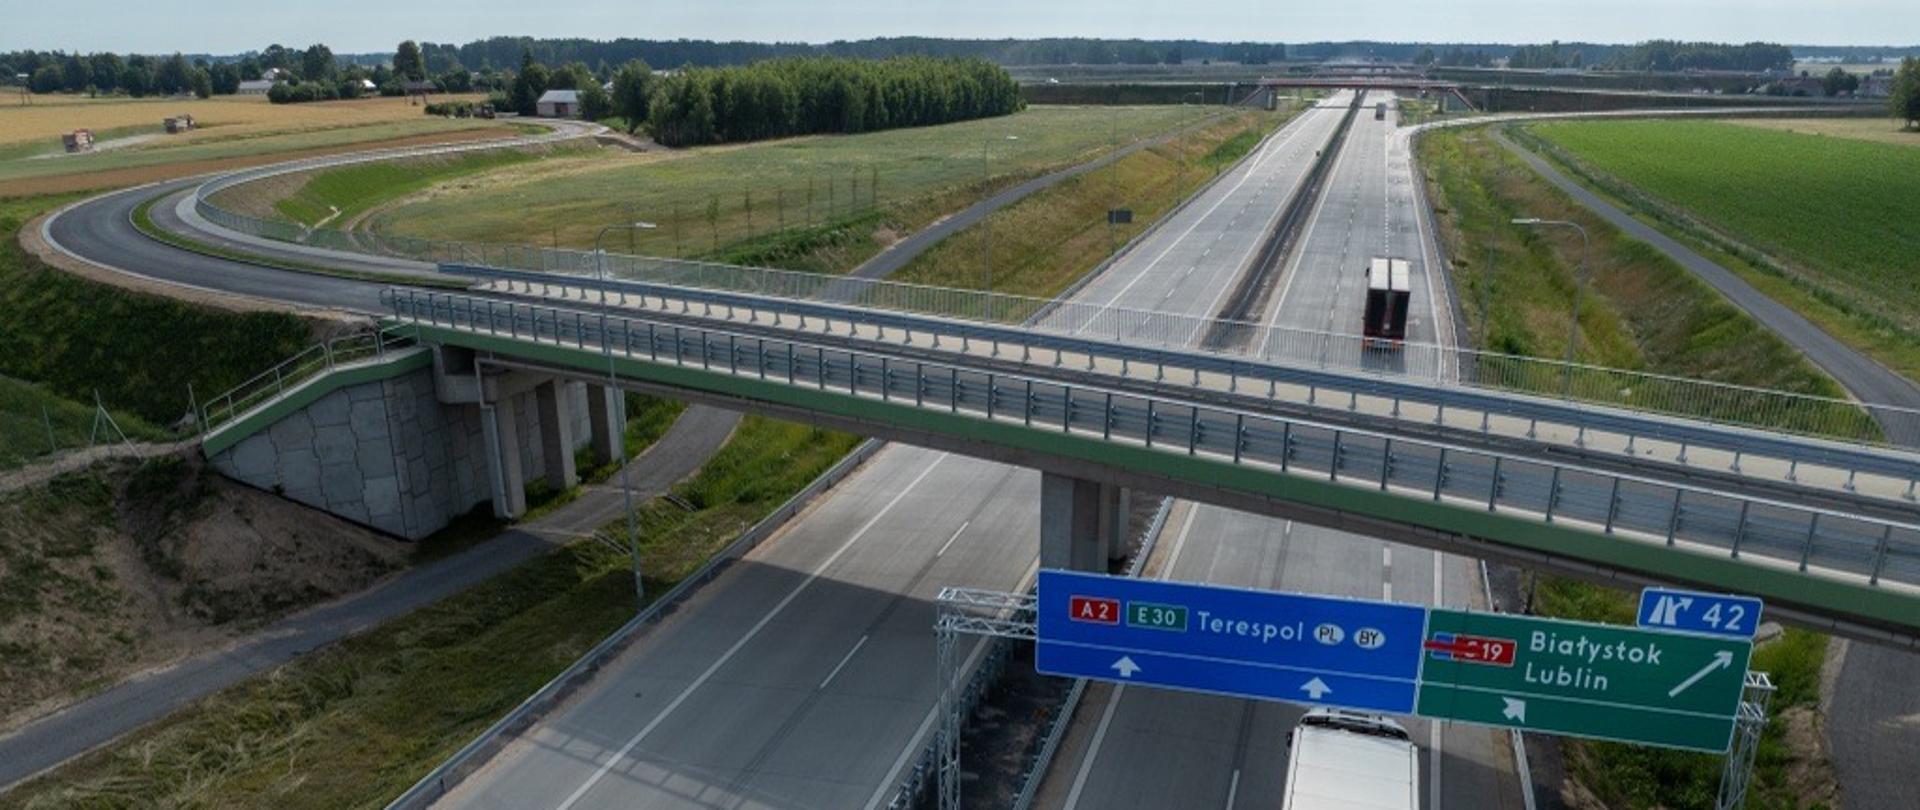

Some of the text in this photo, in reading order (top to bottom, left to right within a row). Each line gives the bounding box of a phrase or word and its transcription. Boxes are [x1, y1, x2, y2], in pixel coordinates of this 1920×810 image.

[1198, 611, 1303, 644] Terespol
[1319, 626, 1338, 643] PL
[1358, 631, 1379, 646] BY
[1702, 603, 1745, 631] 42
[1530, 631, 1663, 666] Białystok
[1525, 662, 1608, 691] Lublin
